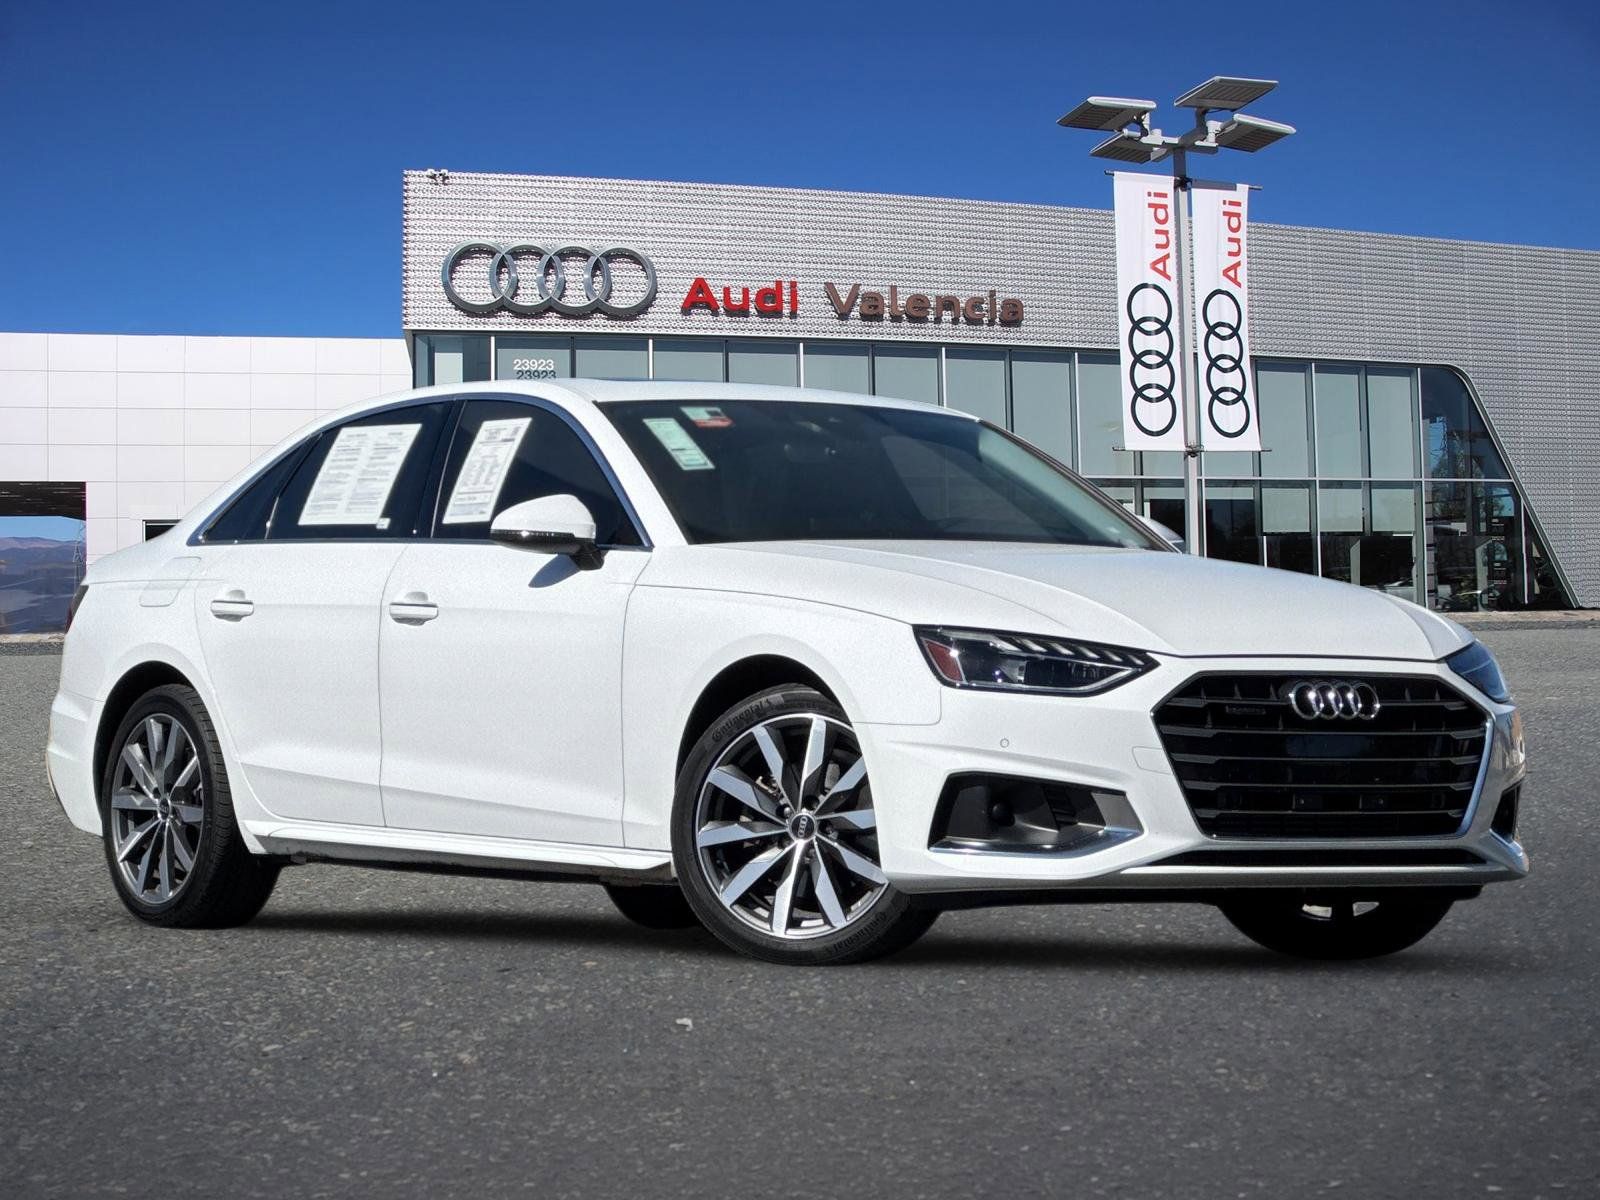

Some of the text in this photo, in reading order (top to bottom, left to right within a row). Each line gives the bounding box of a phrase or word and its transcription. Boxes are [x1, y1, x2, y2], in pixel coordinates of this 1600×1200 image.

[1147, 190, 1171, 282] Audi
[1222, 199, 1243, 289] Audi
[681, 276, 1025, 323] Audi Valencia
[513, 359, 554, 371] 23923
